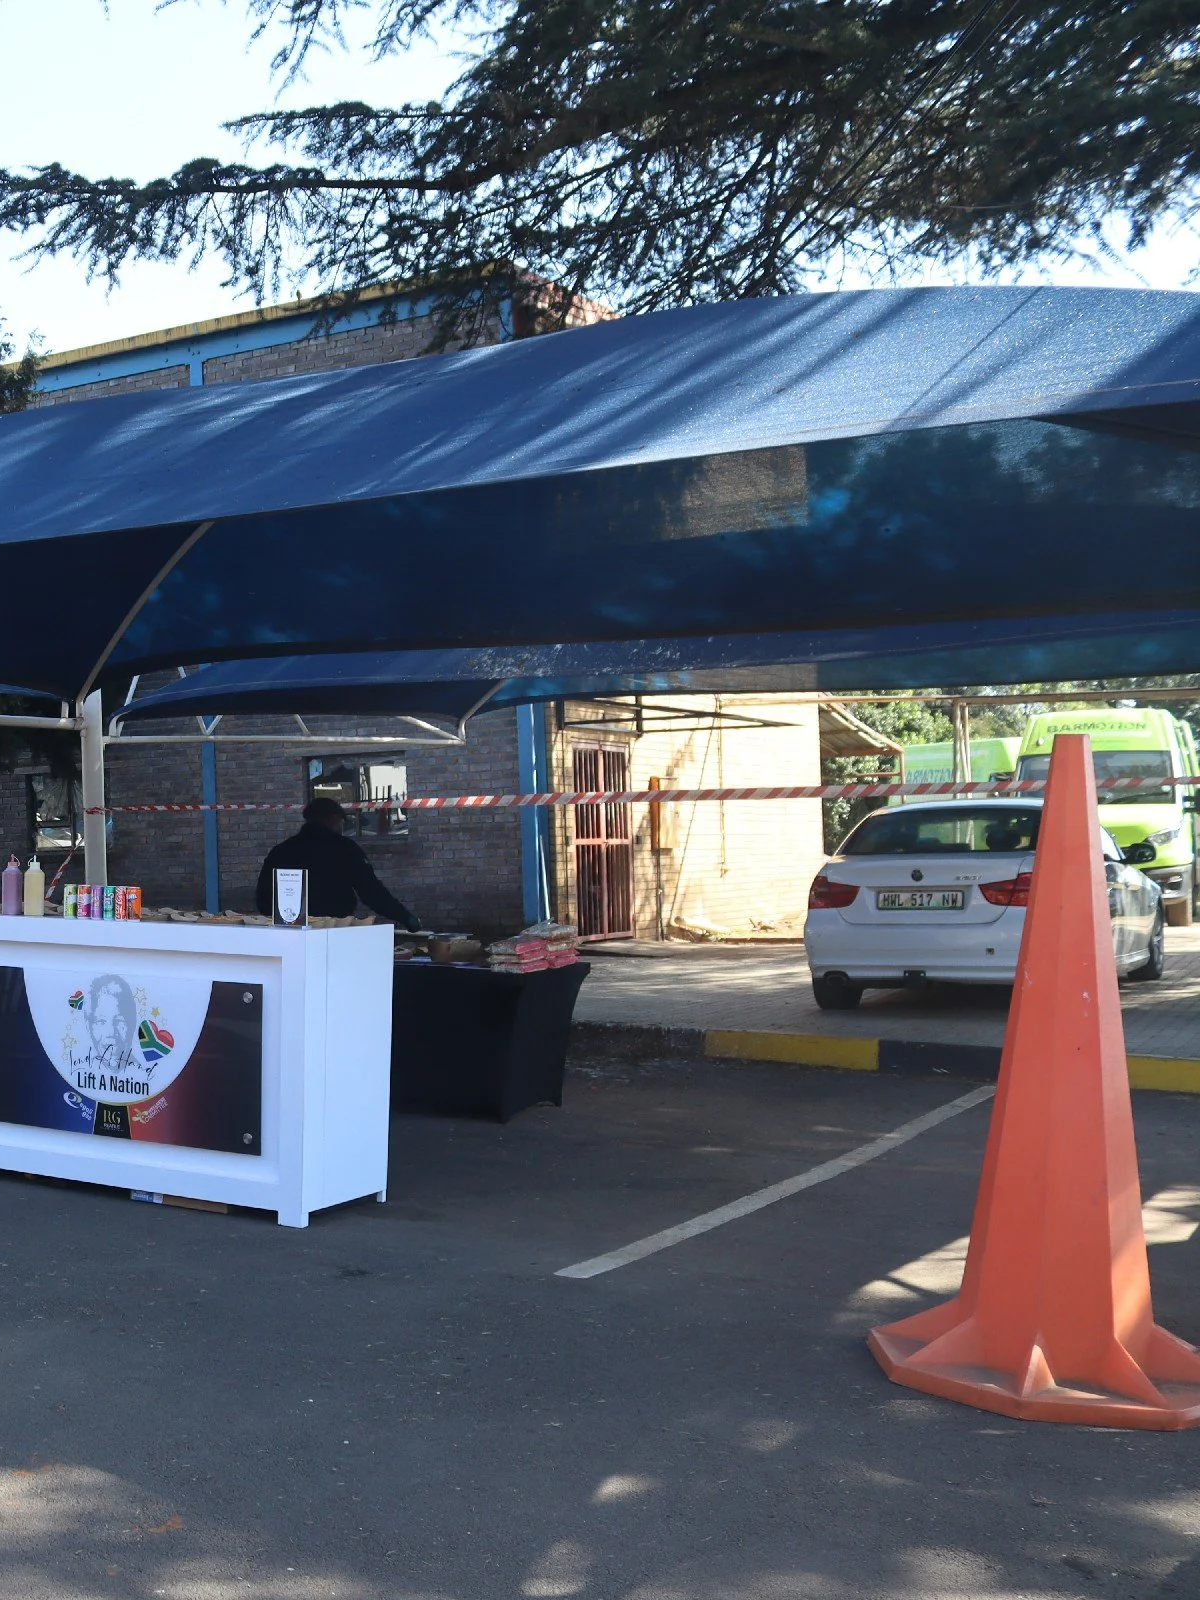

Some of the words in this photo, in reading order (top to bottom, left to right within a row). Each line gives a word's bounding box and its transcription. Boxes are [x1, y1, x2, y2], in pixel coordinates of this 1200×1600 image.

[1047, 722, 1147, 733] BARMOTION
[911, 893, 933, 906] 517
[942, 893, 958, 906] NW
[77, 1072, 96, 1090] Lift
[99, 1074, 106, 1091] A
[110, 1075, 149, 1096] Nation
